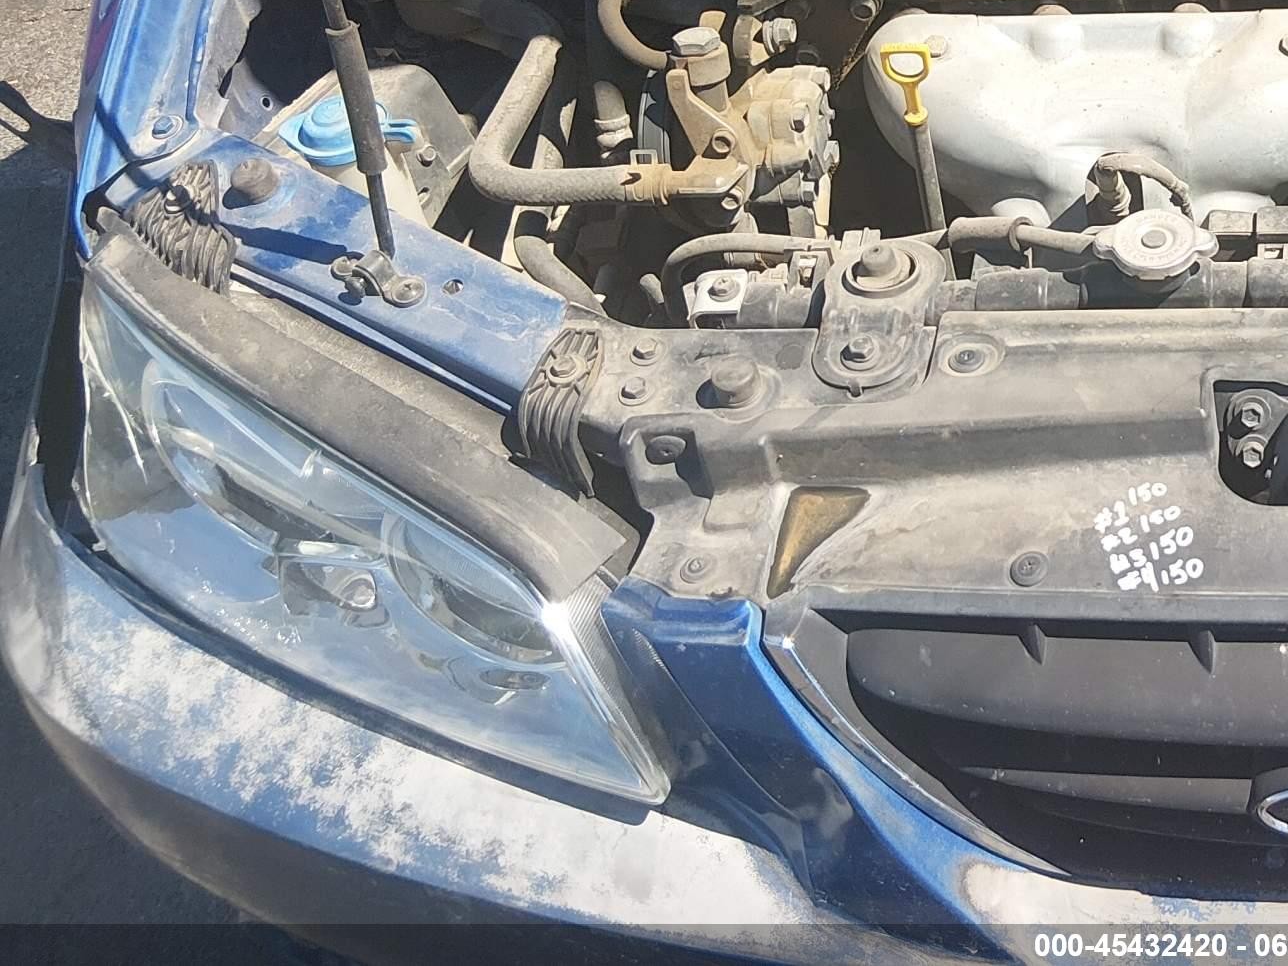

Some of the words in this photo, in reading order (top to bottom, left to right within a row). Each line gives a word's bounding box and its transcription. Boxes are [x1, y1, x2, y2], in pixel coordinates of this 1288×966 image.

[1128, 482, 1168, 506] 150
[1149, 526, 1194, 560] 150
[1161, 558, 1204, 585] 150
